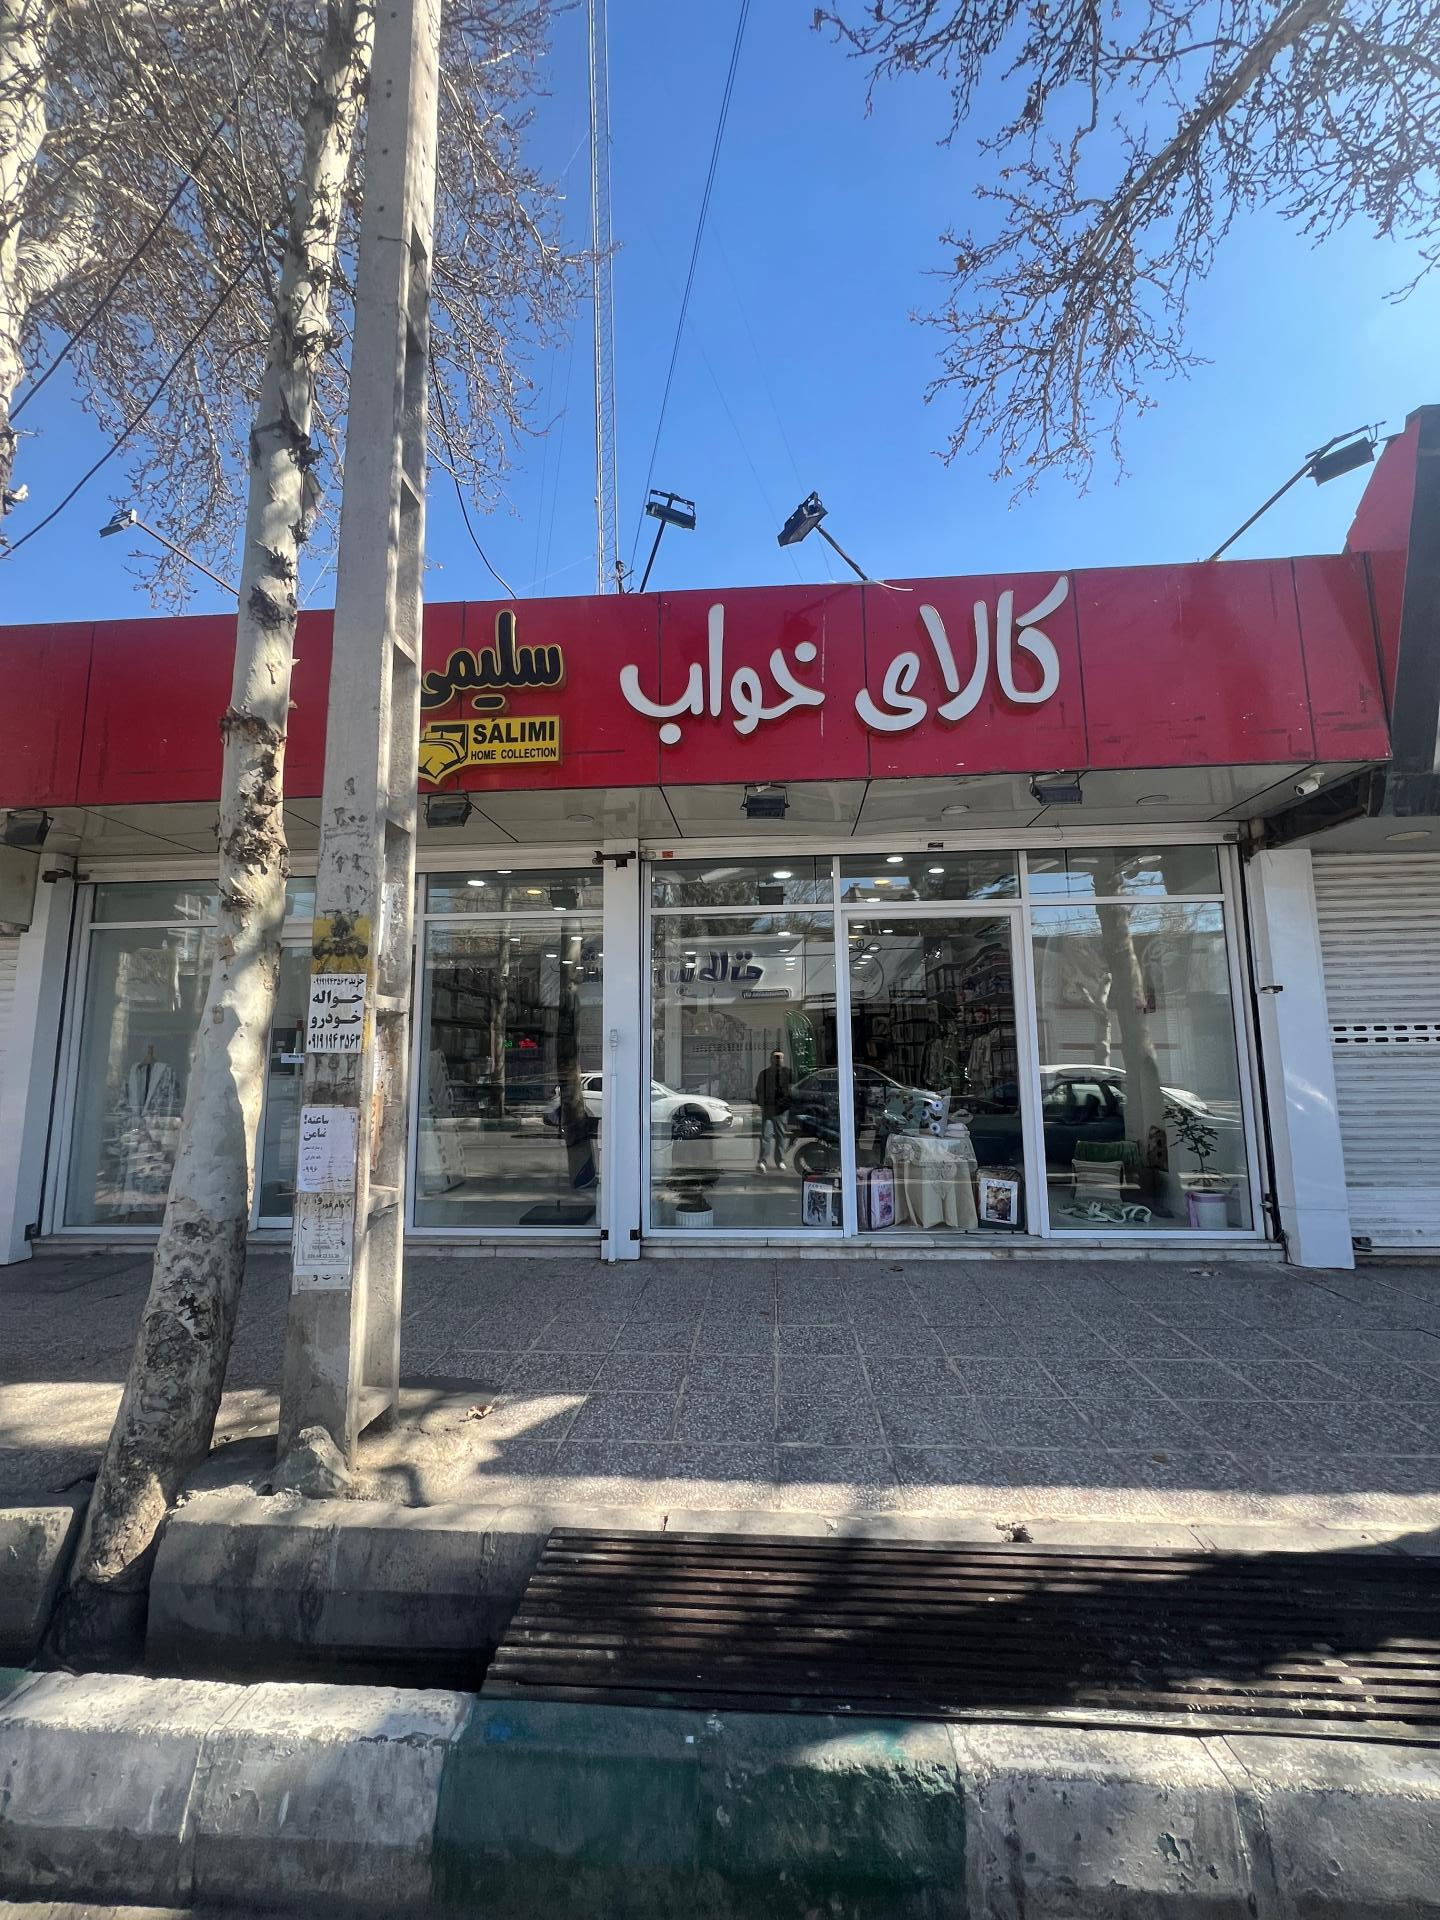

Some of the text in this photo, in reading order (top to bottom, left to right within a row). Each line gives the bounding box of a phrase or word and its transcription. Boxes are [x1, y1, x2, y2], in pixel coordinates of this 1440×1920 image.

[619, 575, 1069, 745] کالای خواب
[470, 747, 557, 761] HOME COLLECTION
[312, 990, 364, 1008] حواله
[309, 1010, 362, 1029] خودرو
